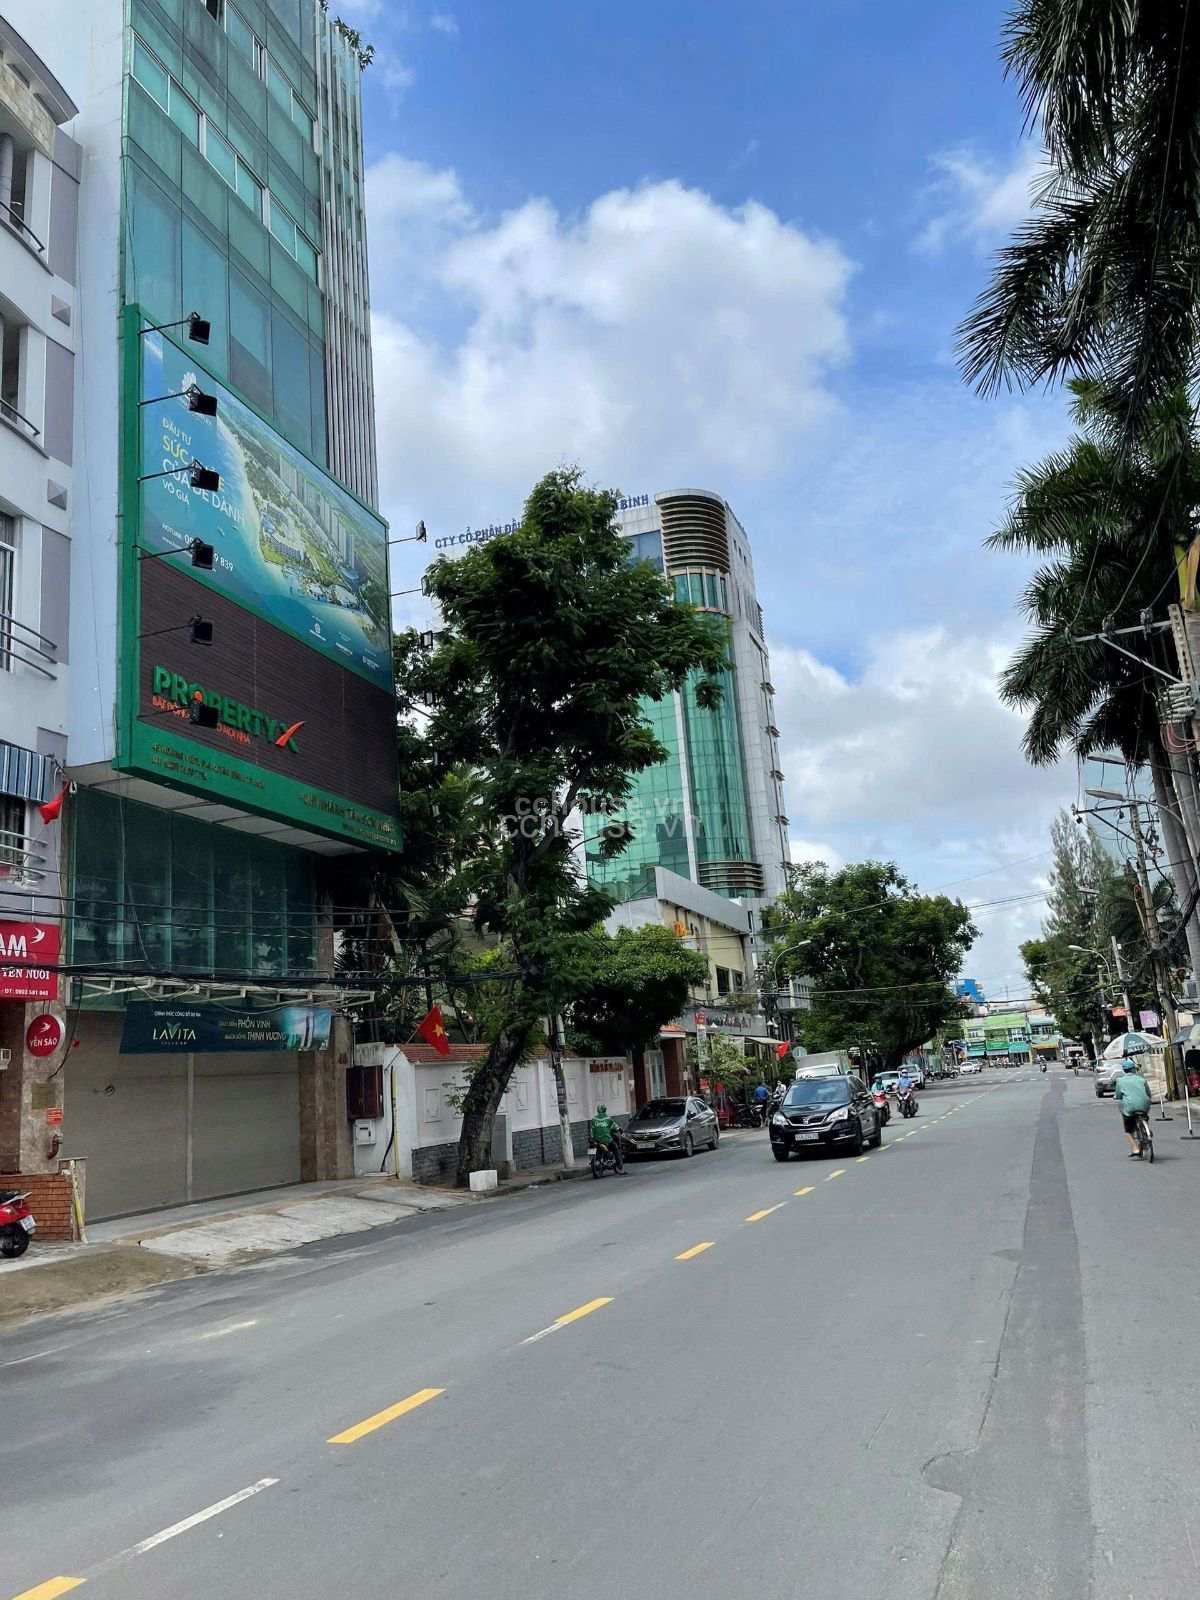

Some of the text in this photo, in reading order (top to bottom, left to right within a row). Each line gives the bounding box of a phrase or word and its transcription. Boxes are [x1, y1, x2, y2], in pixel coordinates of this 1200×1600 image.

[163, 435, 188, 465] SỨC
[162, 478, 190, 506] VÔ GIÁ
[211, 494, 245, 524] DÀNH
[434, 535, 457, 550] CTY
[458, 526, 473, 545] CỔ
[620, 494, 649, 510] BÌNH
[220, 556, 233, 572] 839
[152, 1026, 196, 1040] LAVITA
[256, 1020, 271, 1029] VINH
[29, 1034, 43, 1047] YẾN
